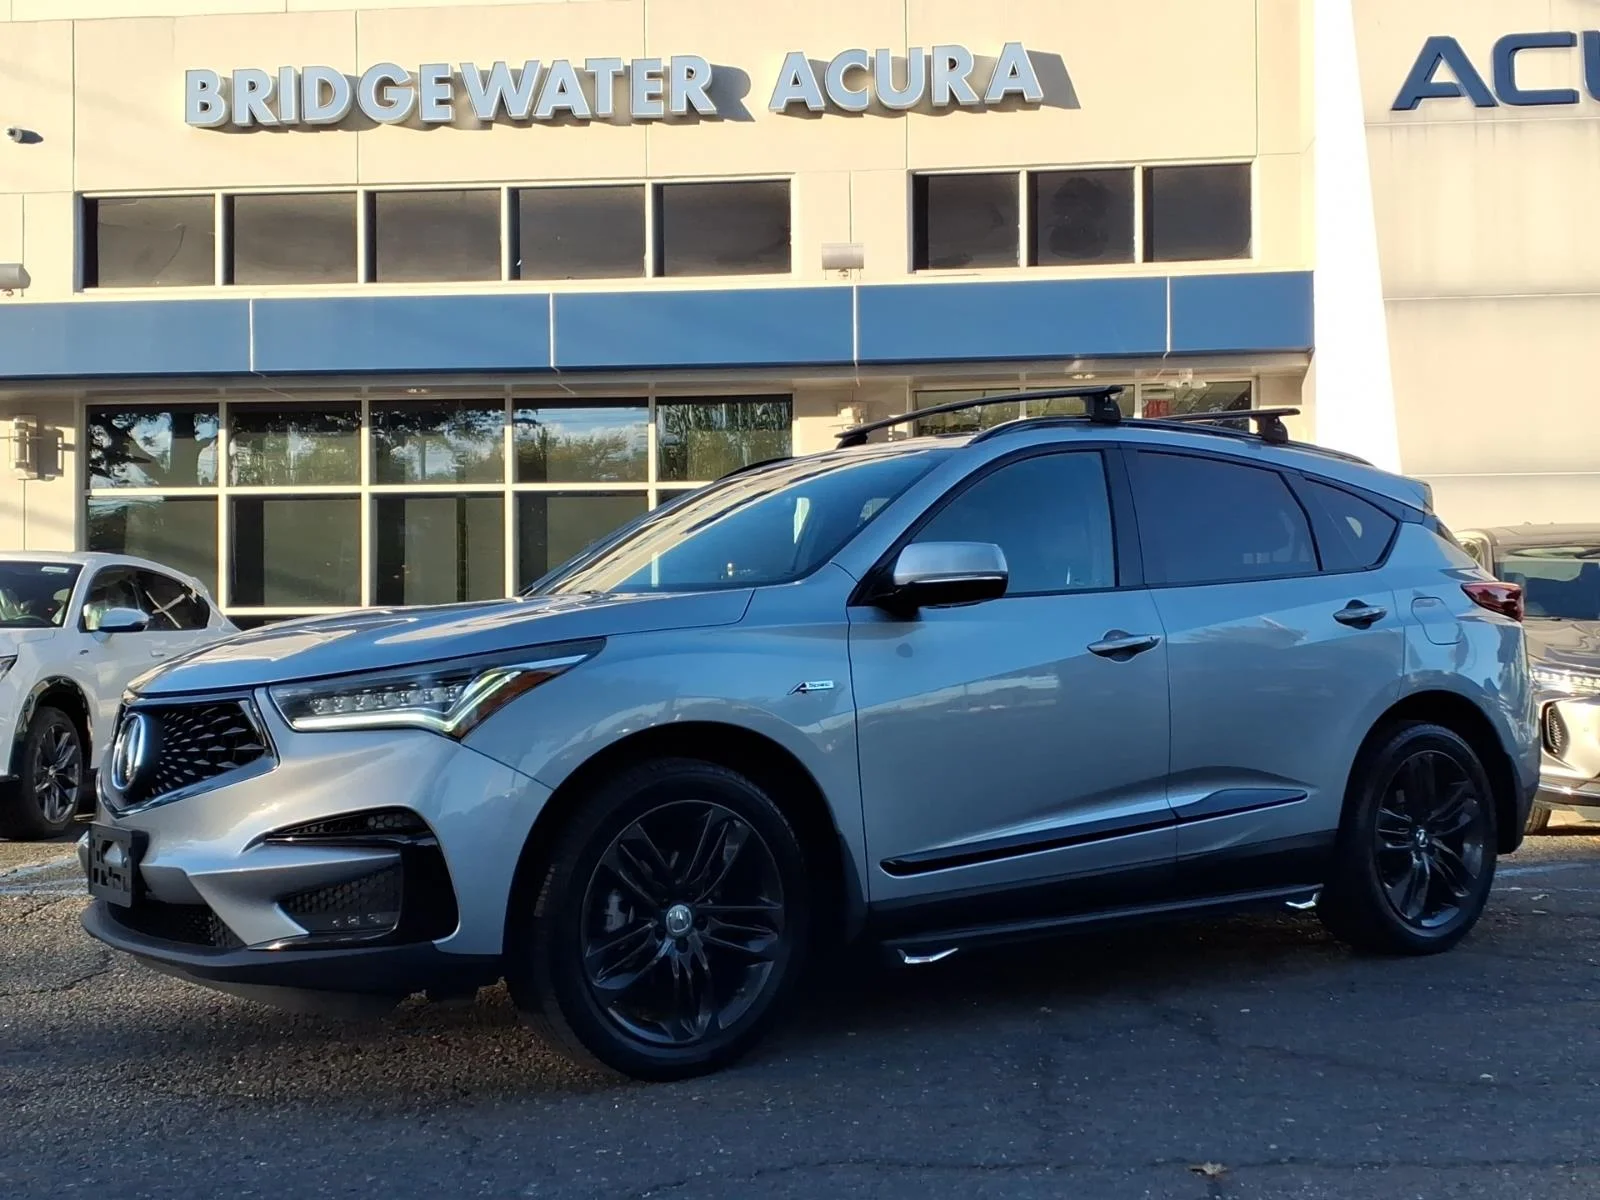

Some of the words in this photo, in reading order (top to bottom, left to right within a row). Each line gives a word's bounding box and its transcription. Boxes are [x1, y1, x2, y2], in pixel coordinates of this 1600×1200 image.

[185, 55, 717, 127] BRIDGEWATER
[768, 42, 1044, 113] ACURA
[1391, 30, 1600, 111] AC
